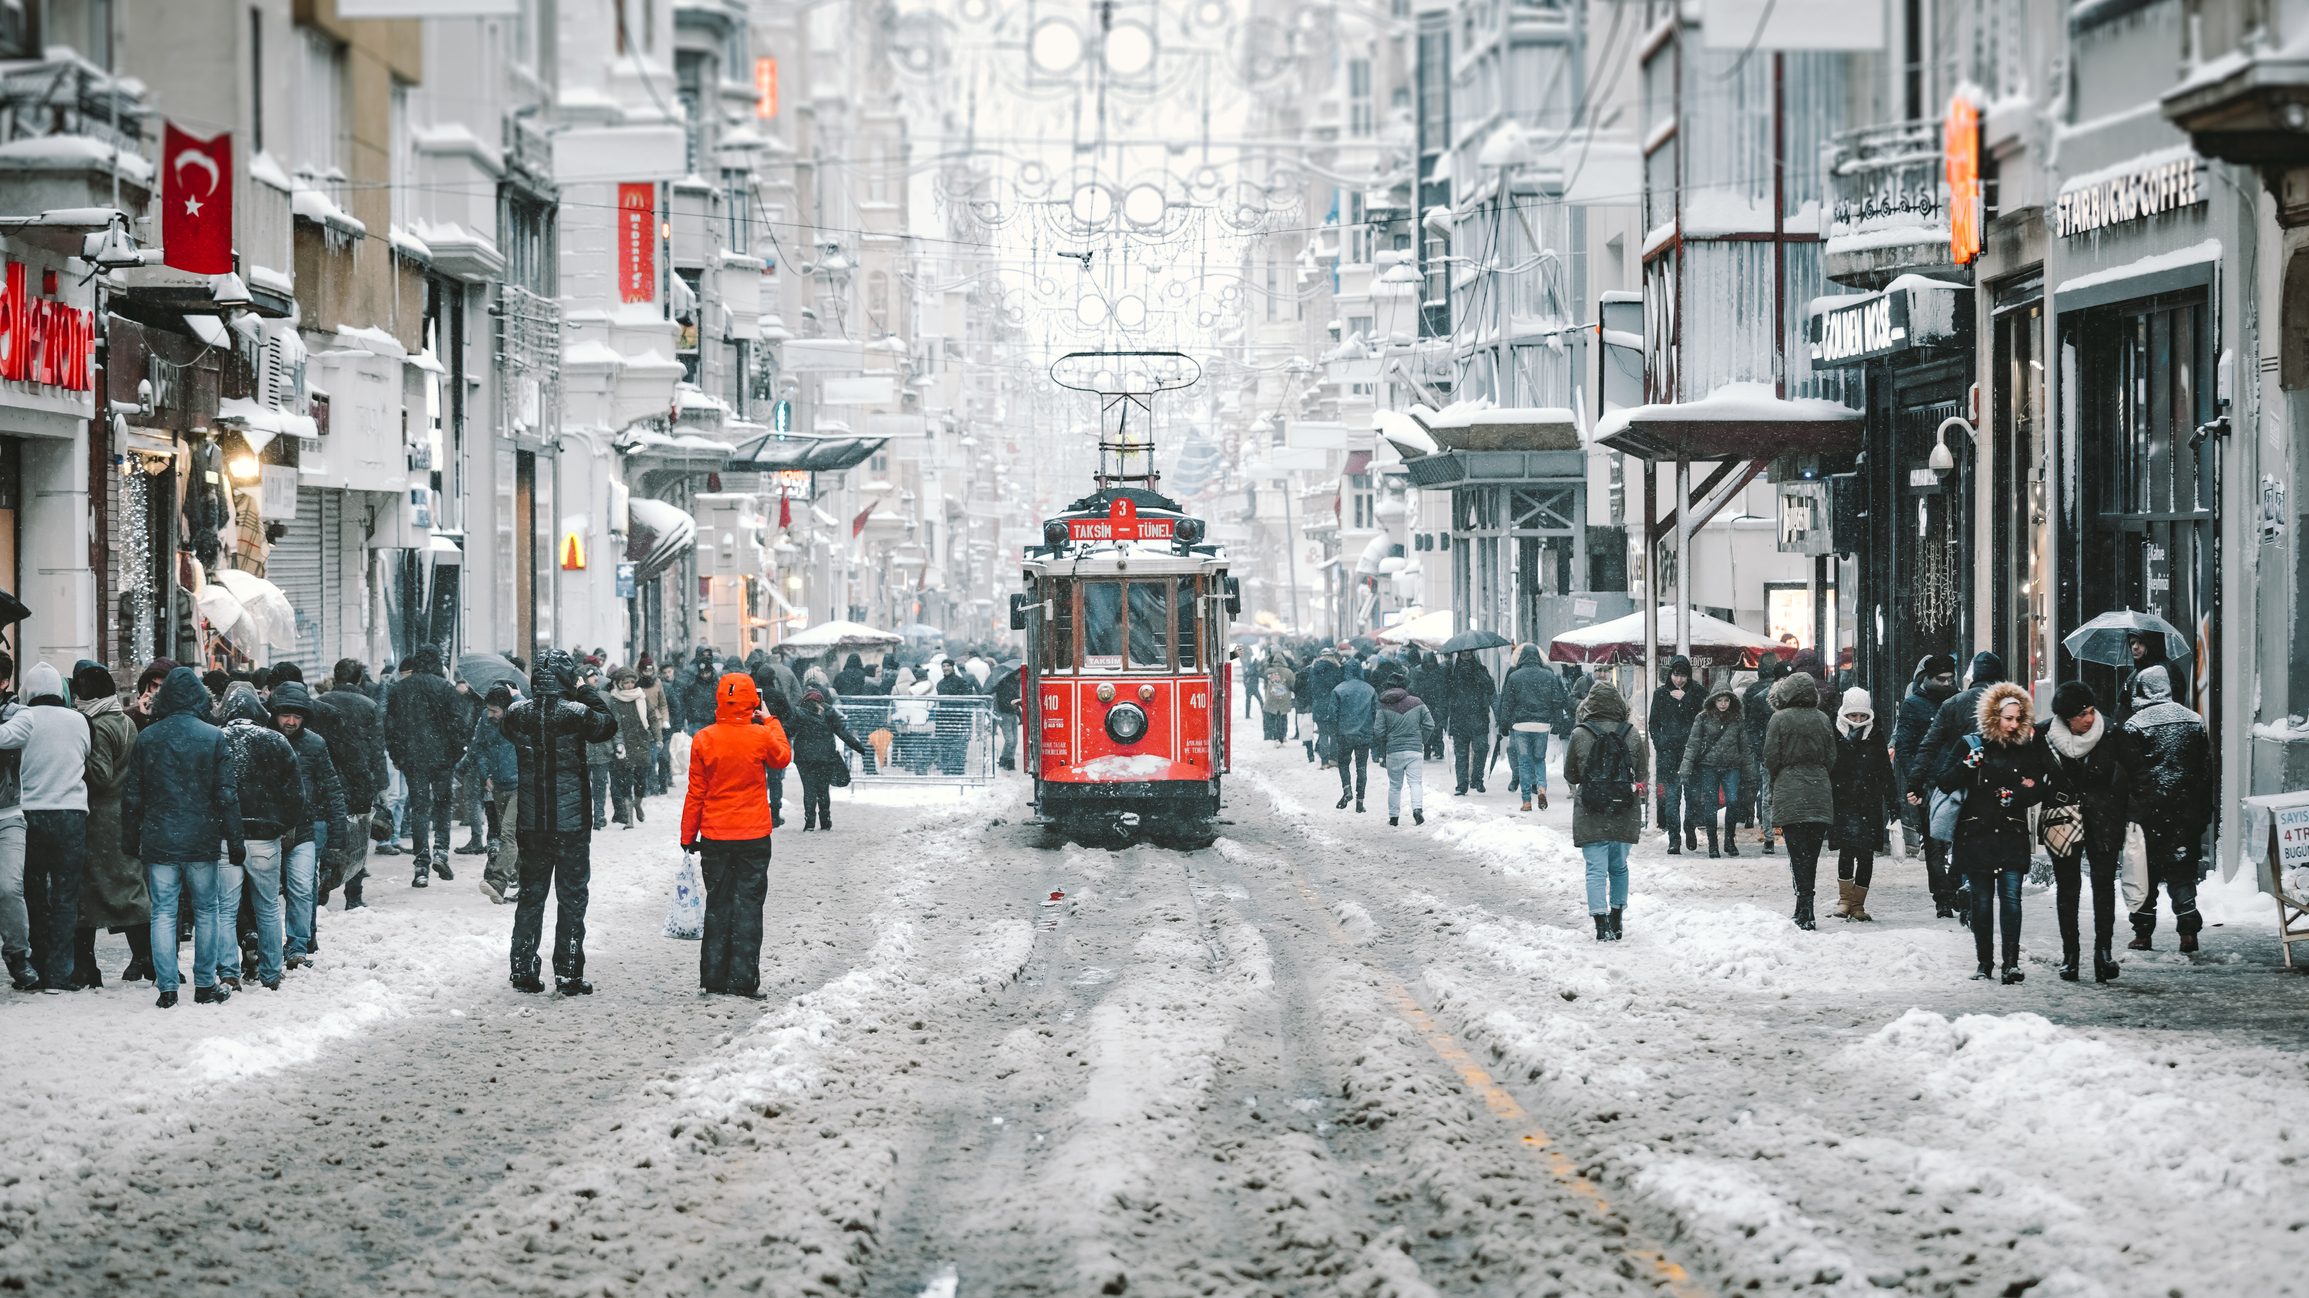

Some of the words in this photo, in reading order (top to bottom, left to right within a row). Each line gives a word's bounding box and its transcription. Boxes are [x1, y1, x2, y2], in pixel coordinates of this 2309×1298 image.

[2056, 175, 2137, 238] STARBUCKS
[2140, 158, 2198, 217] COFFEE
[1822, 307, 1863, 361] GOLDEN
[1864, 294, 1892, 352] ROSE
[1119, 500, 1127, 516] 3
[1073, 522, 1112, 538] TAKSİM
[1137, 521, 1173, 538] TÜNEL
[1043, 694, 1059, 710] 410
[1190, 693, 1206, 709] 410
[2283, 829, 2293, 842] 4
